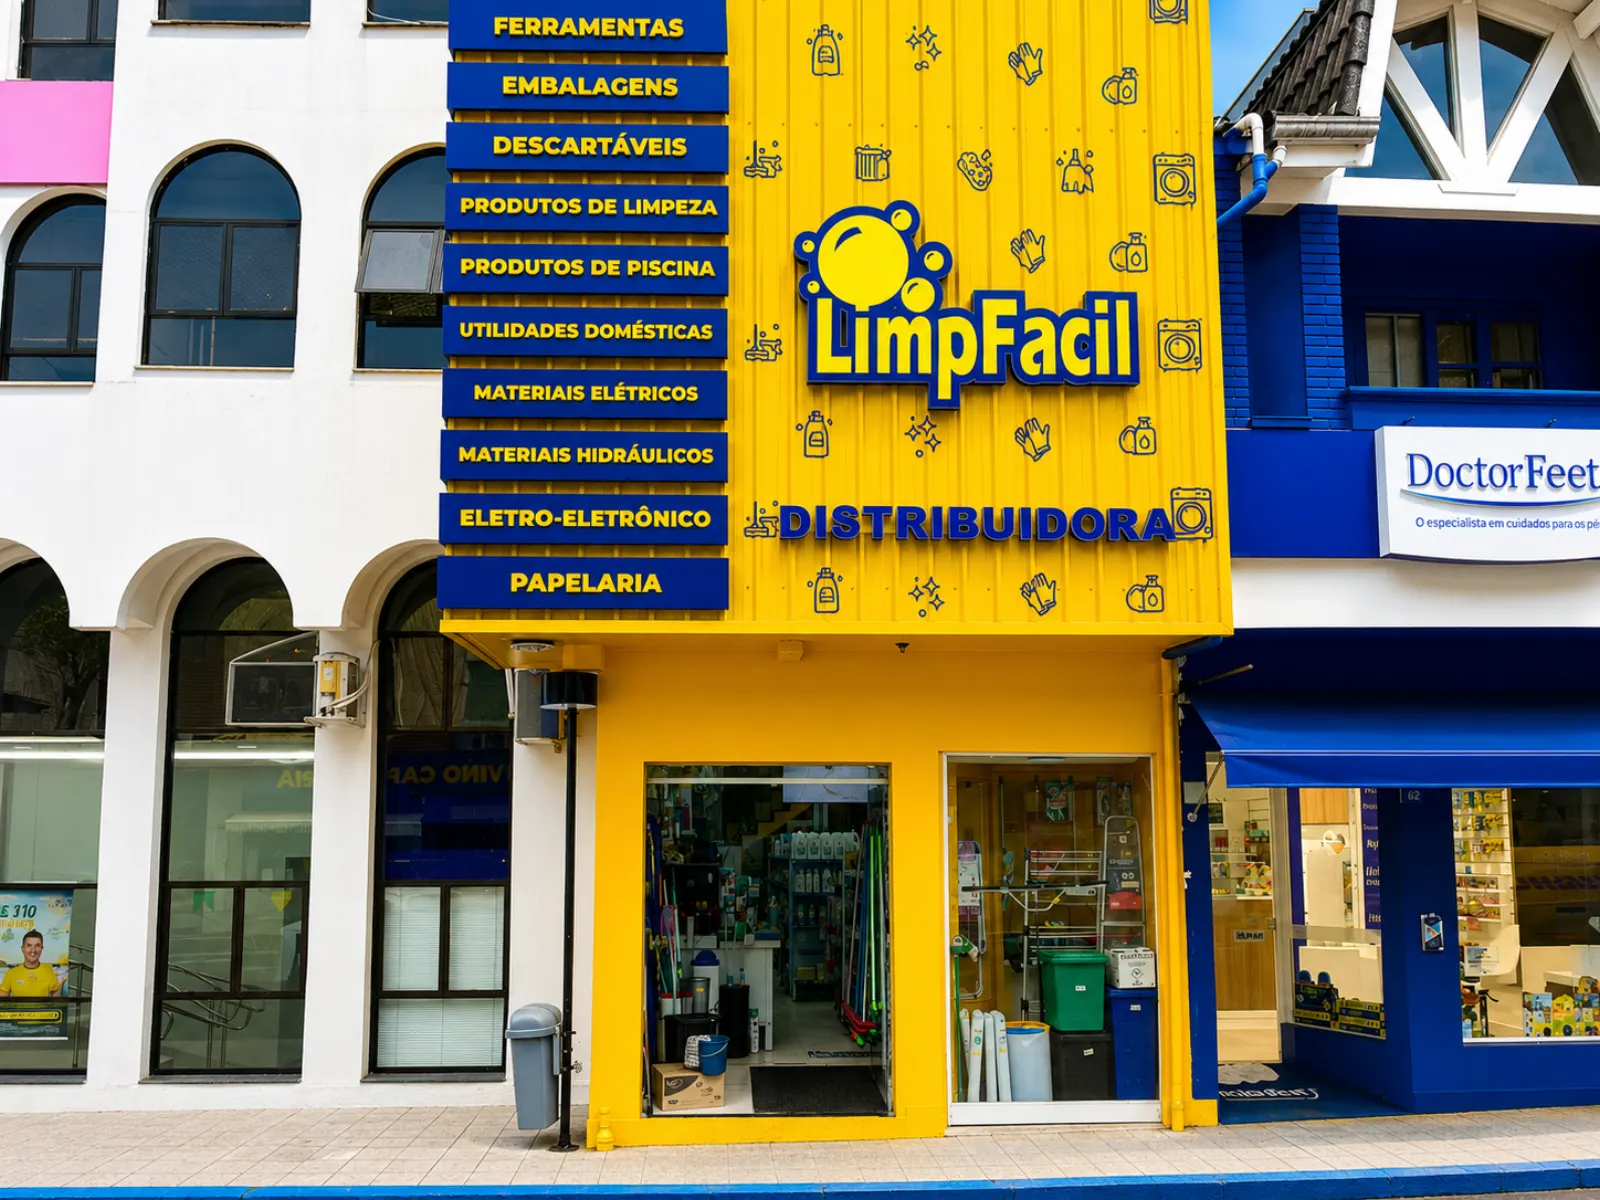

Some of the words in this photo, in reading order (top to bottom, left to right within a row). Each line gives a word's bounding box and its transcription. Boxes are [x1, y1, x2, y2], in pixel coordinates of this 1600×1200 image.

[495, 17, 684, 37] FERRAMENTAS
[503, 76, 678, 96] EMBALAGENS
[494, 133, 687, 155] DESCARTÁVEIS
[461, 198, 581, 213] PRODUTOS
[589, 199, 616, 214] DE
[624, 199, 717, 215] LIMPEZA
[461, 259, 584, 275] PRODUTOS
[591, 260, 620, 275] DE
[628, 260, 715, 276] PISCINA
[460, 323, 579, 338] UTILIDADES
[585, 320, 712, 339] DOMÉSTICAS
[816, 297, 1132, 400] LimpFacil
[475, 385, 584, 400] MATERIAIS
[591, 382, 698, 401] ELÉTRICOS
[459, 447, 571, 462] MATERIAIS
[578, 444, 713, 463] HIDRÁULICOS
[1406, 453, 1600, 490] DoctorFeet
[461, 506, 711, 527] ELETRO-ELETRÔNICO
[779, 504, 1176, 541] DISTRIBUIDORA
[1416, 517, 1425, 528] O
[1427, 517, 1487, 530] especialista
[1488, 520, 1505, 529] em
[1506, 518, 1551, 529] cuidados
[1552, 520, 1573, 530] para
[1574, 521, 1586, 529] os
[511, 573, 662, 592] PAPELARIA
